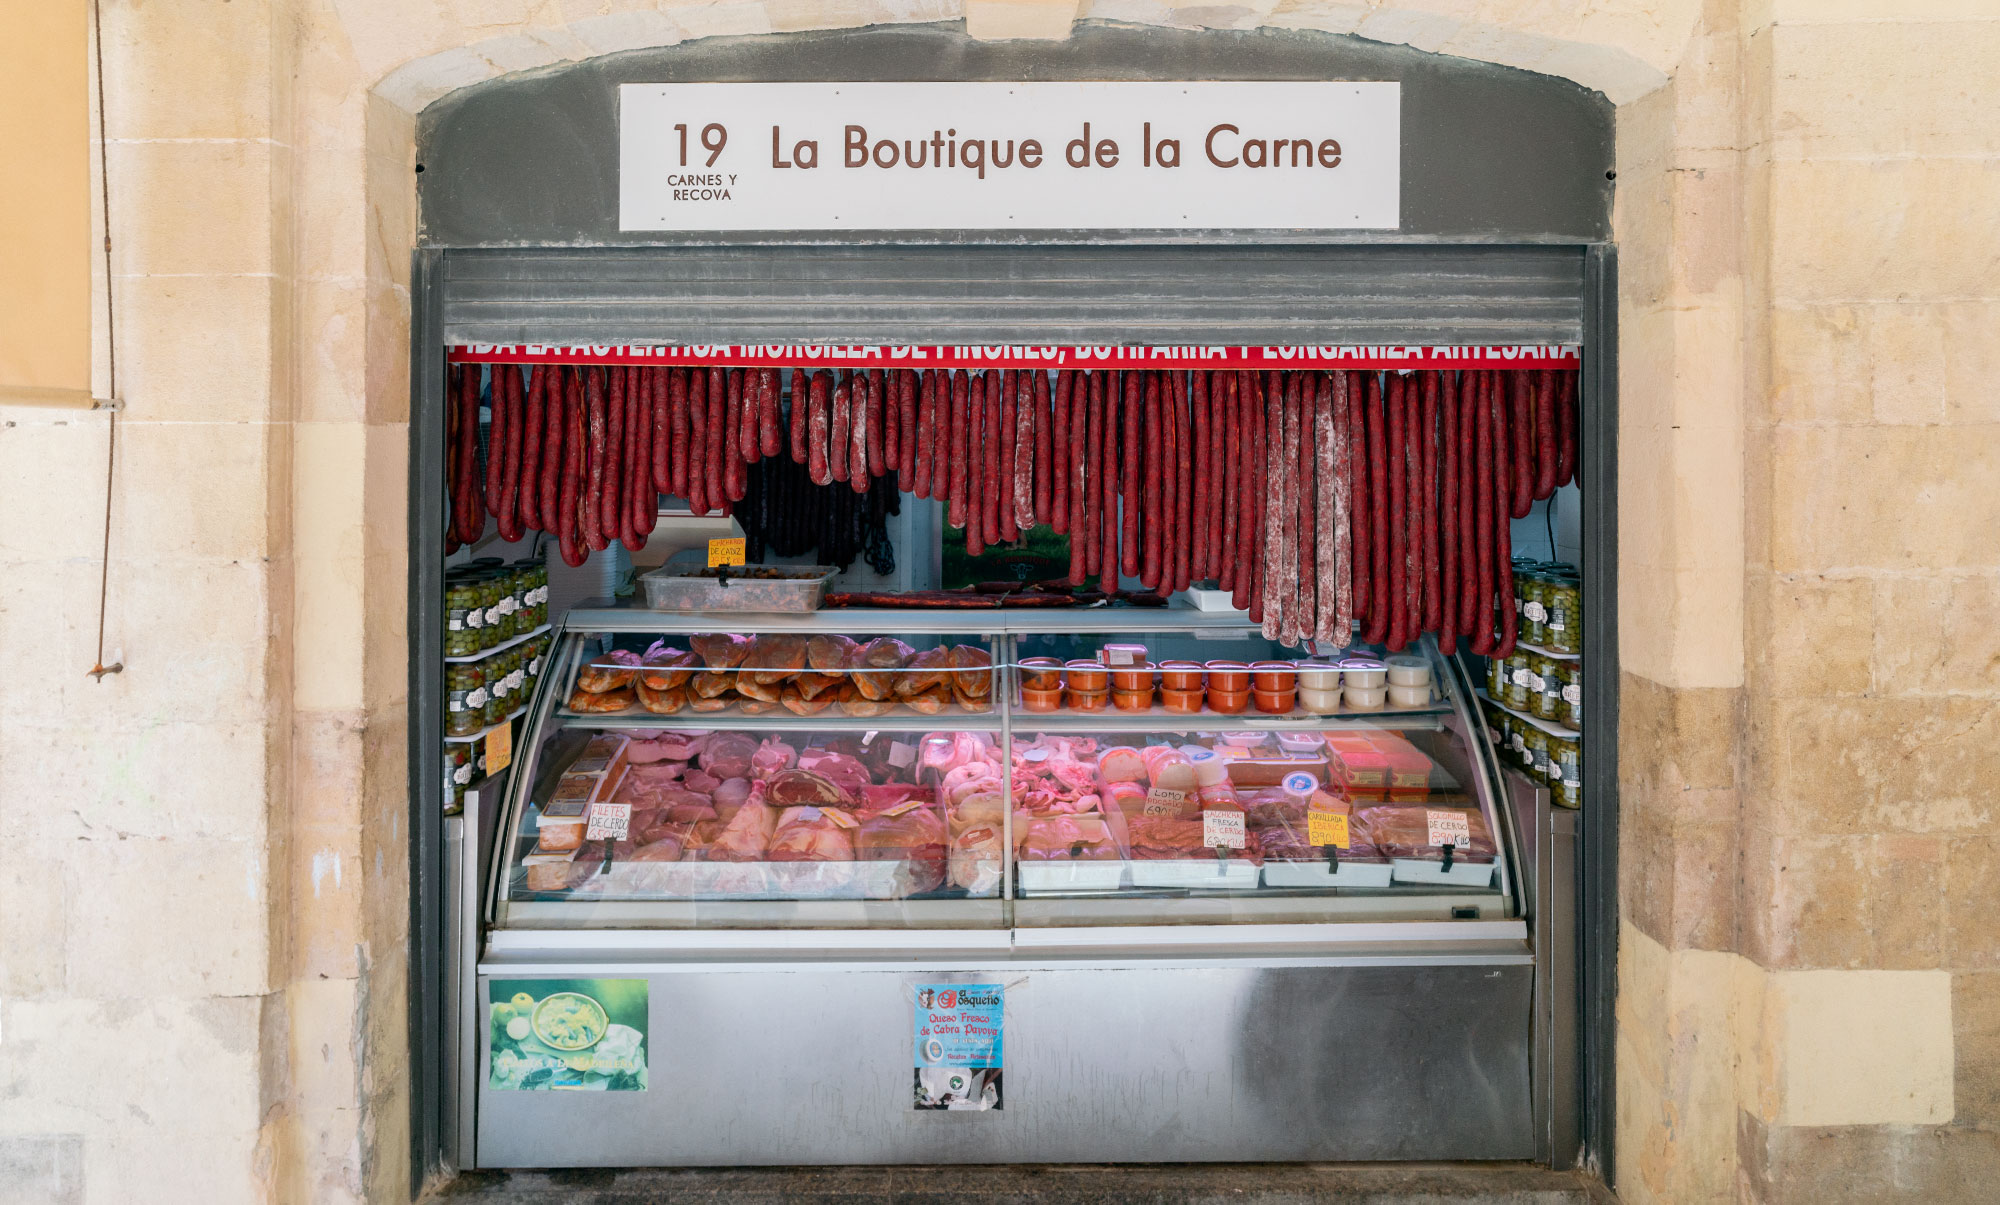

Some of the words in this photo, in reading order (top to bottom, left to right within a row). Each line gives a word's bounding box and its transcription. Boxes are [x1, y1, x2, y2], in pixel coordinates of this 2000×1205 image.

[673, 123, 728, 168] 19
[772, 125, 818, 169] La
[844, 125, 1043, 179] Boutique
[1065, 122, 1119, 168] de
[1143, 122, 1180, 168] la
[1205, 123, 1342, 168] Carne
[667, 174, 722, 186] CARNES
[728, 174, 738, 186] Y
[673, 188, 732, 201] RECOVA
[1154, 789, 1182, 801] LOMO
[591, 804, 626, 818] FILETES
[590, 816, 603, 827] DE
[604, 817, 629, 830] CERDO
[1429, 820, 1438, 829] DE
[1440, 822, 1468, 830] CERDO
[1206, 825, 1216, 833] DE
[1219, 827, 1244, 835] CERDO
[929, 1013, 957, 1023] Queso
[960, 1012, 990, 1024] Fresco
[920, 1025, 930, 1036] de
[933, 1024, 960, 1035] Cabra
